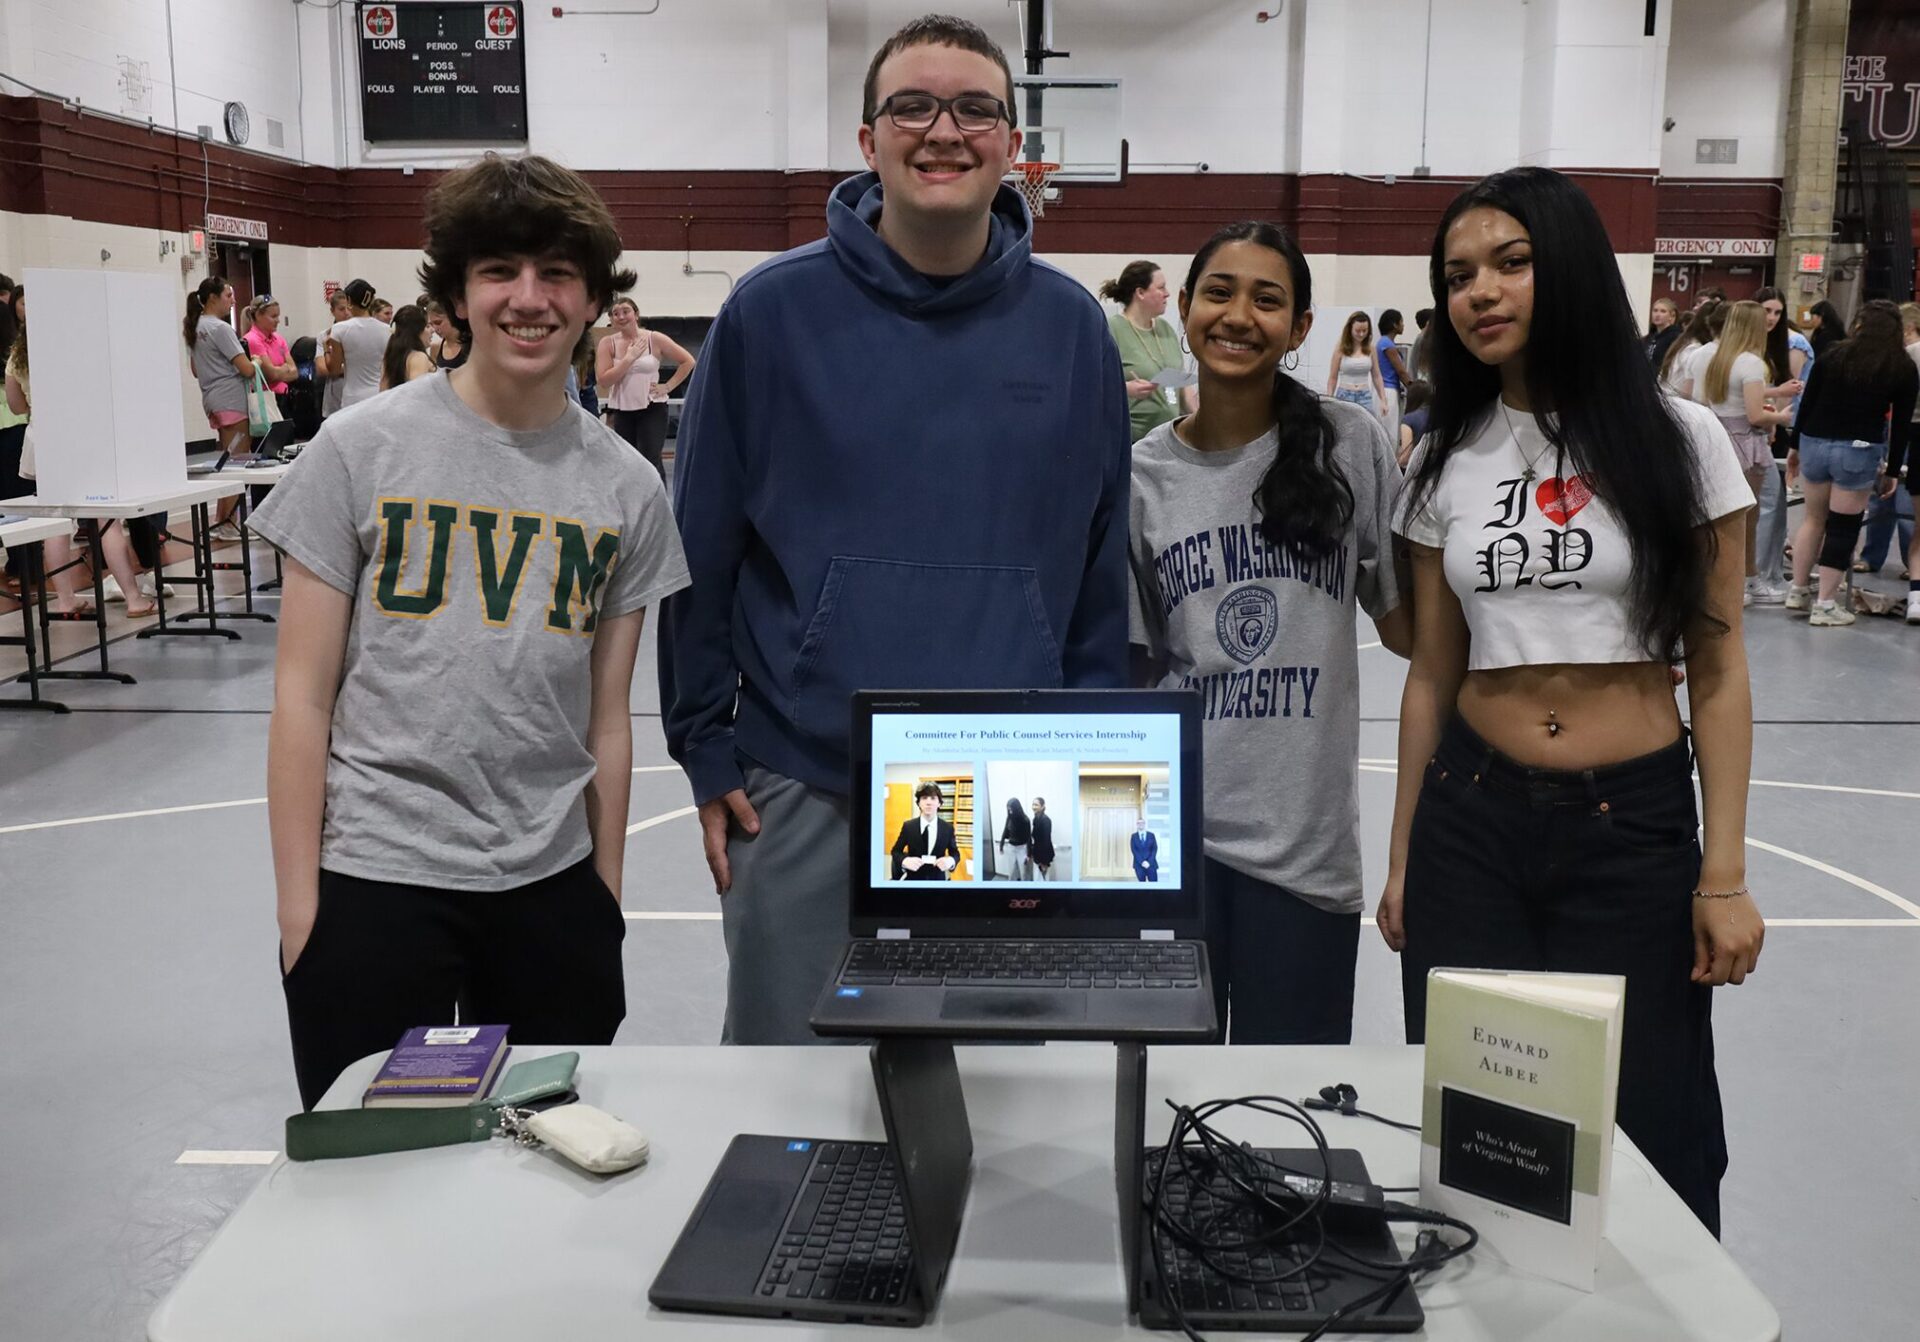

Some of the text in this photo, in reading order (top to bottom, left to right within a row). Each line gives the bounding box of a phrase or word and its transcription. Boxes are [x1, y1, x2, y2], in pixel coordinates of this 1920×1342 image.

[372, 39, 406, 50] LIONS
[426, 42, 458, 50] PERIOD
[475, 40, 512, 50] GUEST
[428, 72, 458, 81] BONUS
[367, 85, 395, 93] FOULS
[413, 86, 445, 94] PLAYER
[456, 86, 478, 94] FOUL
[493, 85, 520, 94] FOULS
[209, 214, 267, 238] EMERGENCY ONLY
[1656, 240, 1773, 254] ERGENCY ONLY
[1667, 267, 1689, 292] 15
[372, 497, 621, 637] UVM
[905, 730, 1147, 740] Committee For Public Counsel Services Internship
[1009, 899, 1041, 909] acer
[1473, 1026, 1549, 1060] EDWARD
[1479, 1056, 1538, 1085] ALBEE
[1475, 1130, 1538, 1159] Who's Afraid
[1461, 1142, 1550, 1176] of Virginia Woolf?
